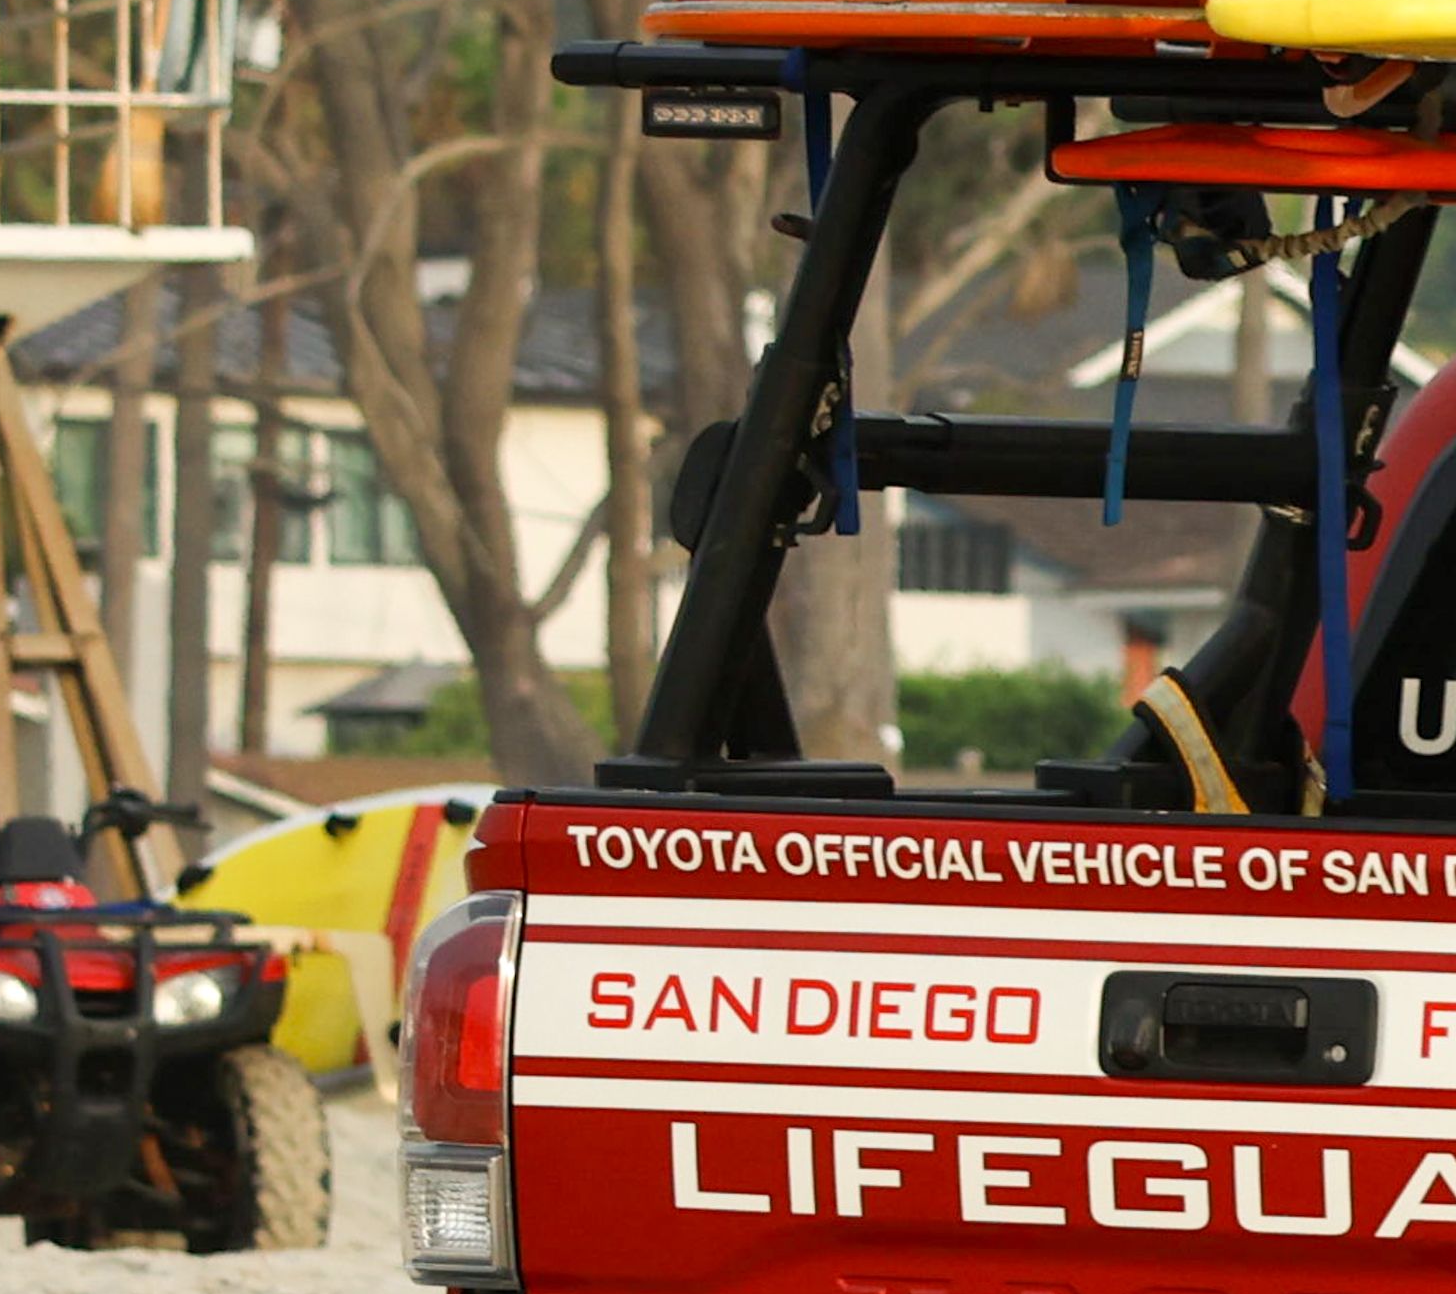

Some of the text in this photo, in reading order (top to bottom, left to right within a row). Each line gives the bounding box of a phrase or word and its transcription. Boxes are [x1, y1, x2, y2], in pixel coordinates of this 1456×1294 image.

[567, 825, 766, 874] TOYOTA
[776, 832, 1002, 883] OFFICIAL
[1008, 840, 1226, 889] VEHICLE
[1239, 847, 1308, 892] OF
[1322, 849, 1428, 897] SAN
[587, 972, 1041, 1045] SAN DIEGO
